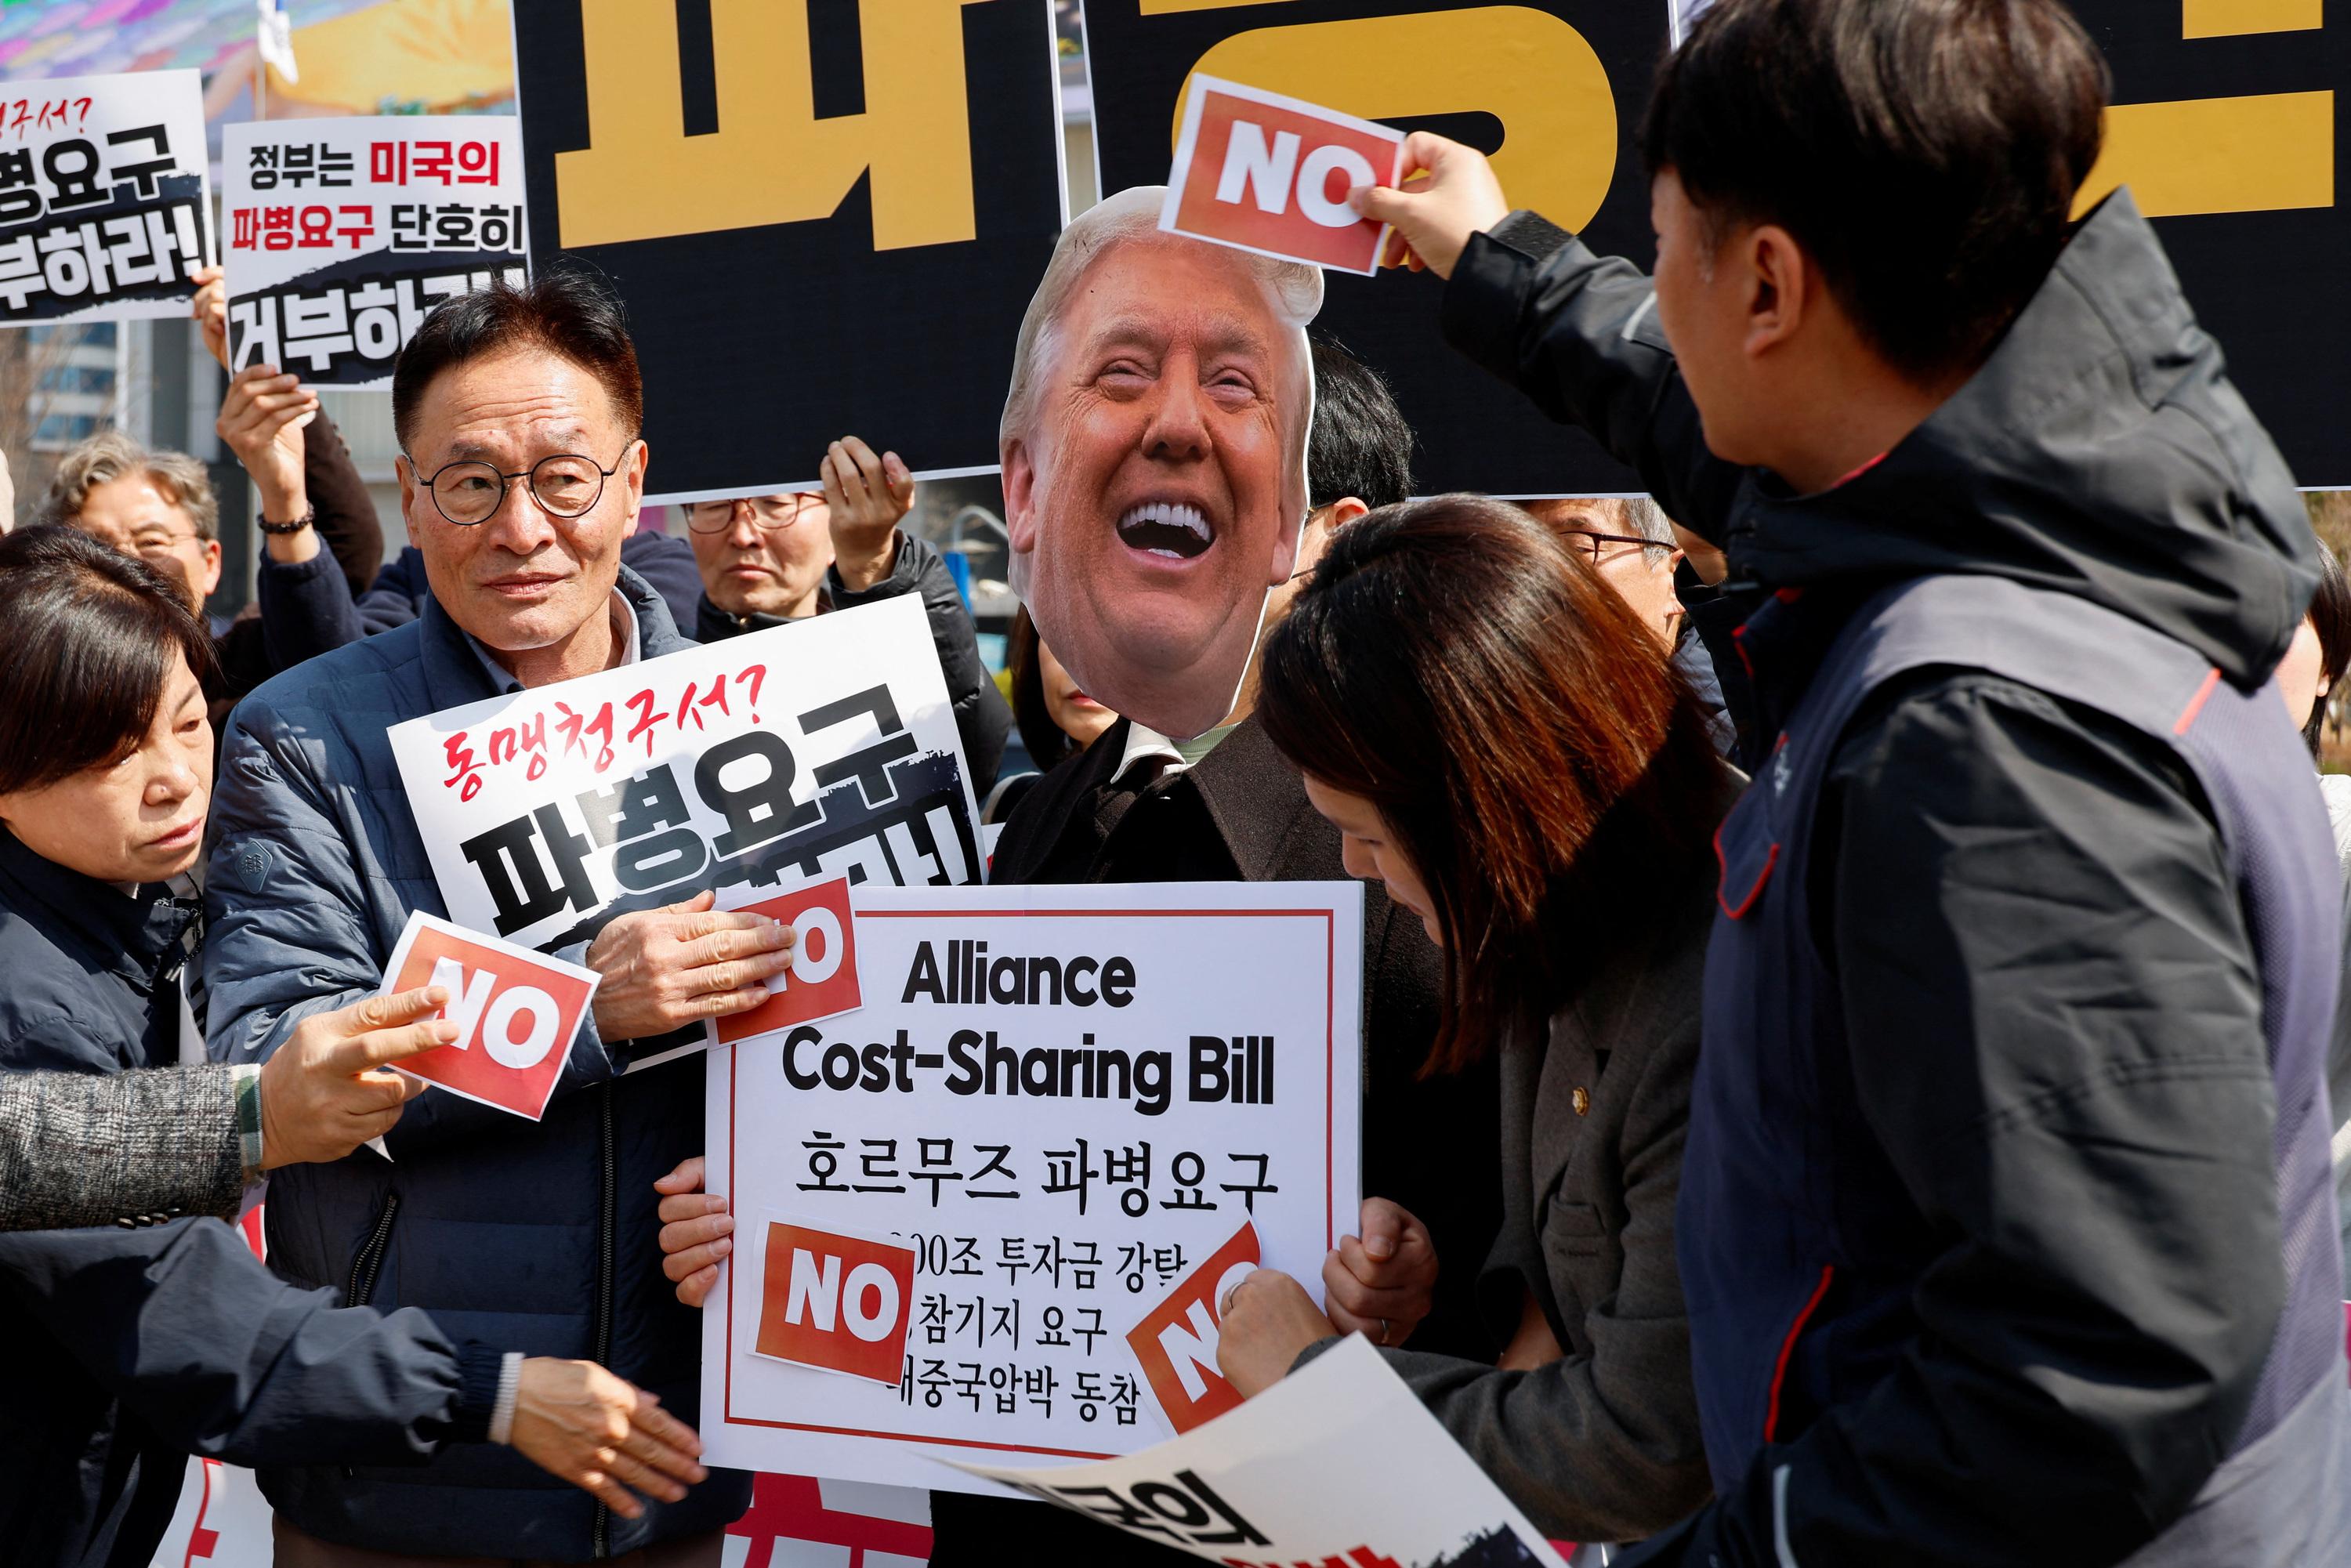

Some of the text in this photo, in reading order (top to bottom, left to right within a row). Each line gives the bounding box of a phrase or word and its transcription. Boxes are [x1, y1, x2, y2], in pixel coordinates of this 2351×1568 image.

[0, 97, 92, 142] 구서?
[249, 141, 500, 190] 정부는 미국의
[1215, 120, 1377, 228] NO
[233, 202, 524, 252] 파병요구 단호히
[230, 267, 527, 374] 거부하
[444, 664, 767, 802] 동맹청구서?
[460, 683, 918, 938] 파병요구
[738, 906, 845, 995] O
[900, 940, 1137, 1008] Alliance
[412, 955, 561, 1070] NO
[782, 1026, 1275, 1116] Cost-Sharing Bill
[795, 1131, 1279, 1218] 호르무즈 파병요구
[784, 1248, 900, 1342] NO
[889, 1232, 984, 1276] 00조
[996, 1236, 1103, 1290] 투자금
[908, 1293, 1108, 1356] 참기지 요구
[1070, 1371, 1141, 1426] 동참
